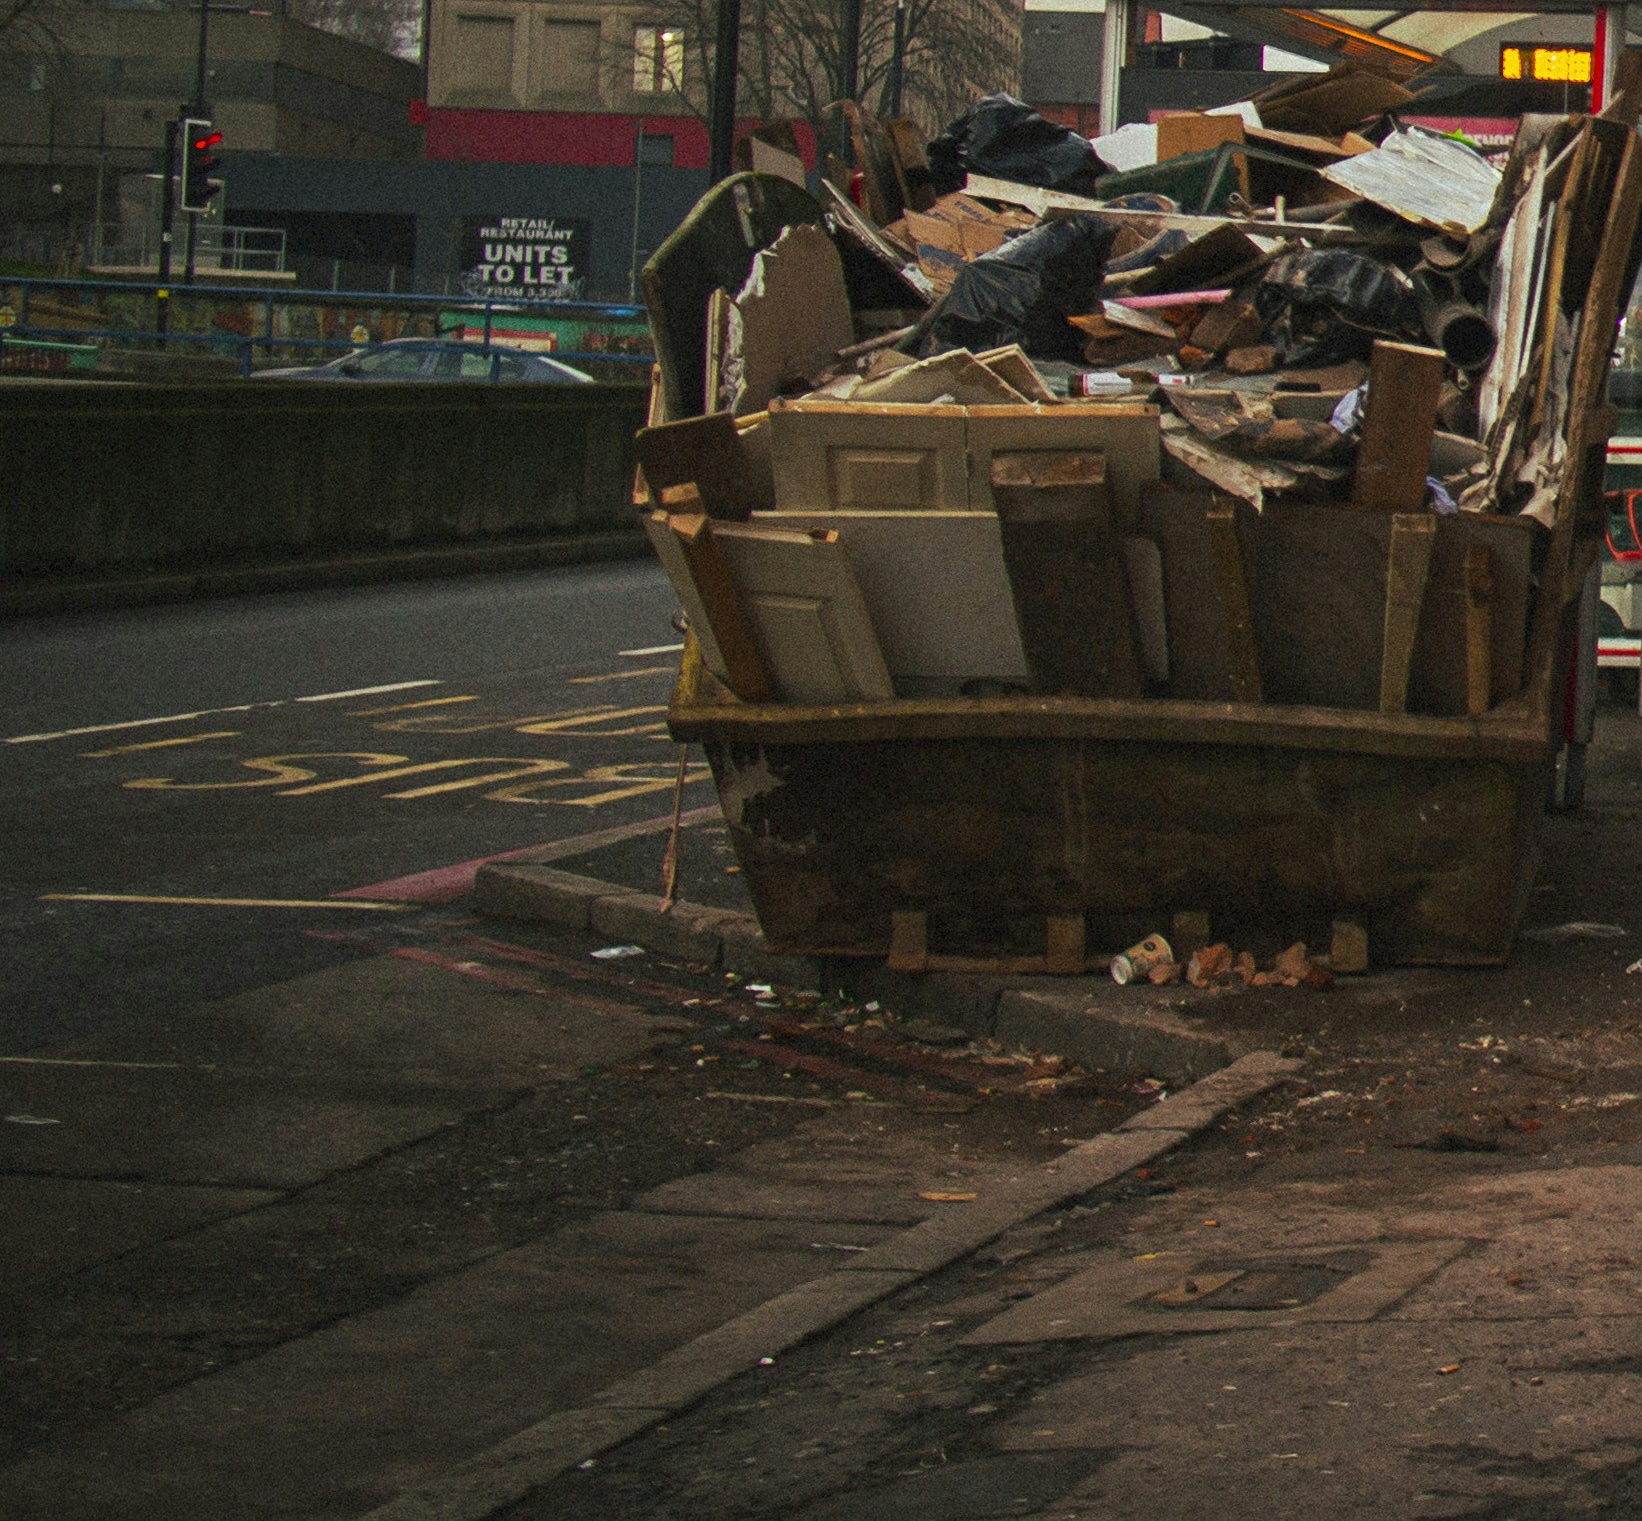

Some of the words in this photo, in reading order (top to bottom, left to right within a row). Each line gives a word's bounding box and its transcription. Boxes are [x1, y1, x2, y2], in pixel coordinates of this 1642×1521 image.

[480, 227, 574, 240] RESTAURANT
[484, 244, 568, 264] UNITS
[478, 264, 515, 283] TO
[523, 265, 575, 284] LET
